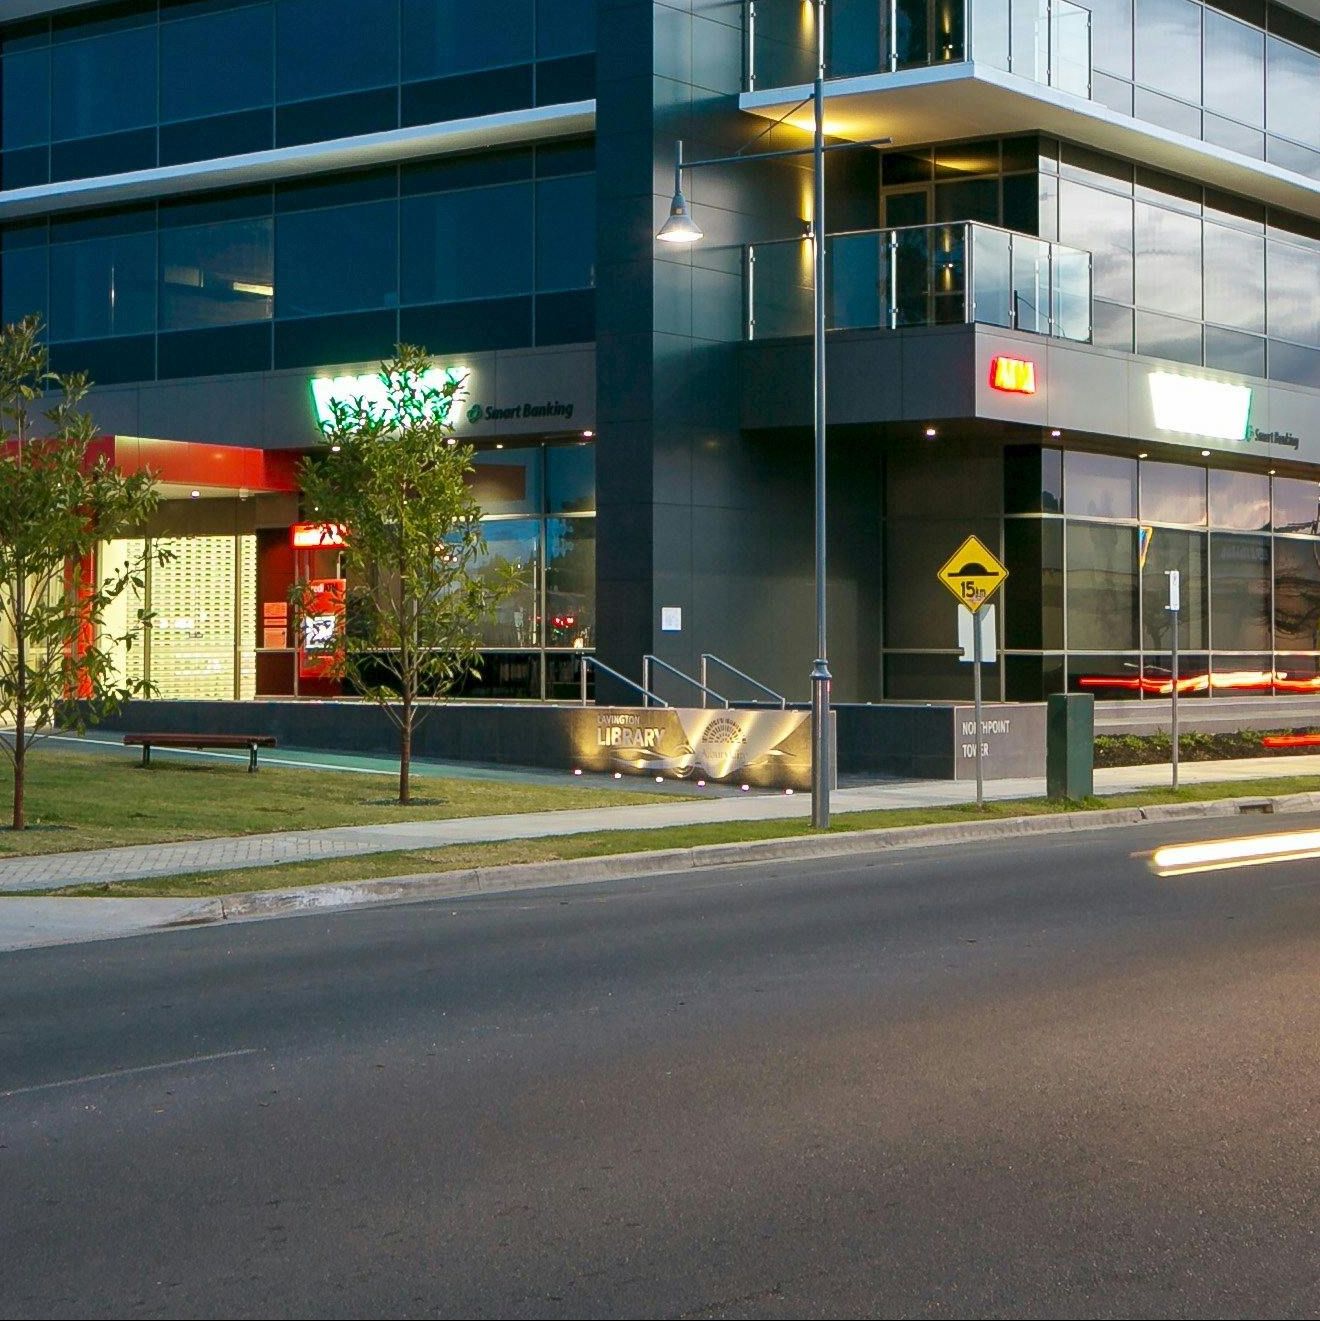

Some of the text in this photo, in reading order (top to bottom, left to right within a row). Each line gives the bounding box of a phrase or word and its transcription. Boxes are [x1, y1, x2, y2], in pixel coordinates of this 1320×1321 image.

[484, 401, 574, 420] Smart Banking
[960, 580, 975, 598] 15
[597, 714, 640, 725] LAVINGTON
[962, 720, 1010, 735] NOHPOINT
[597, 727, 666, 747] LIBRARY
